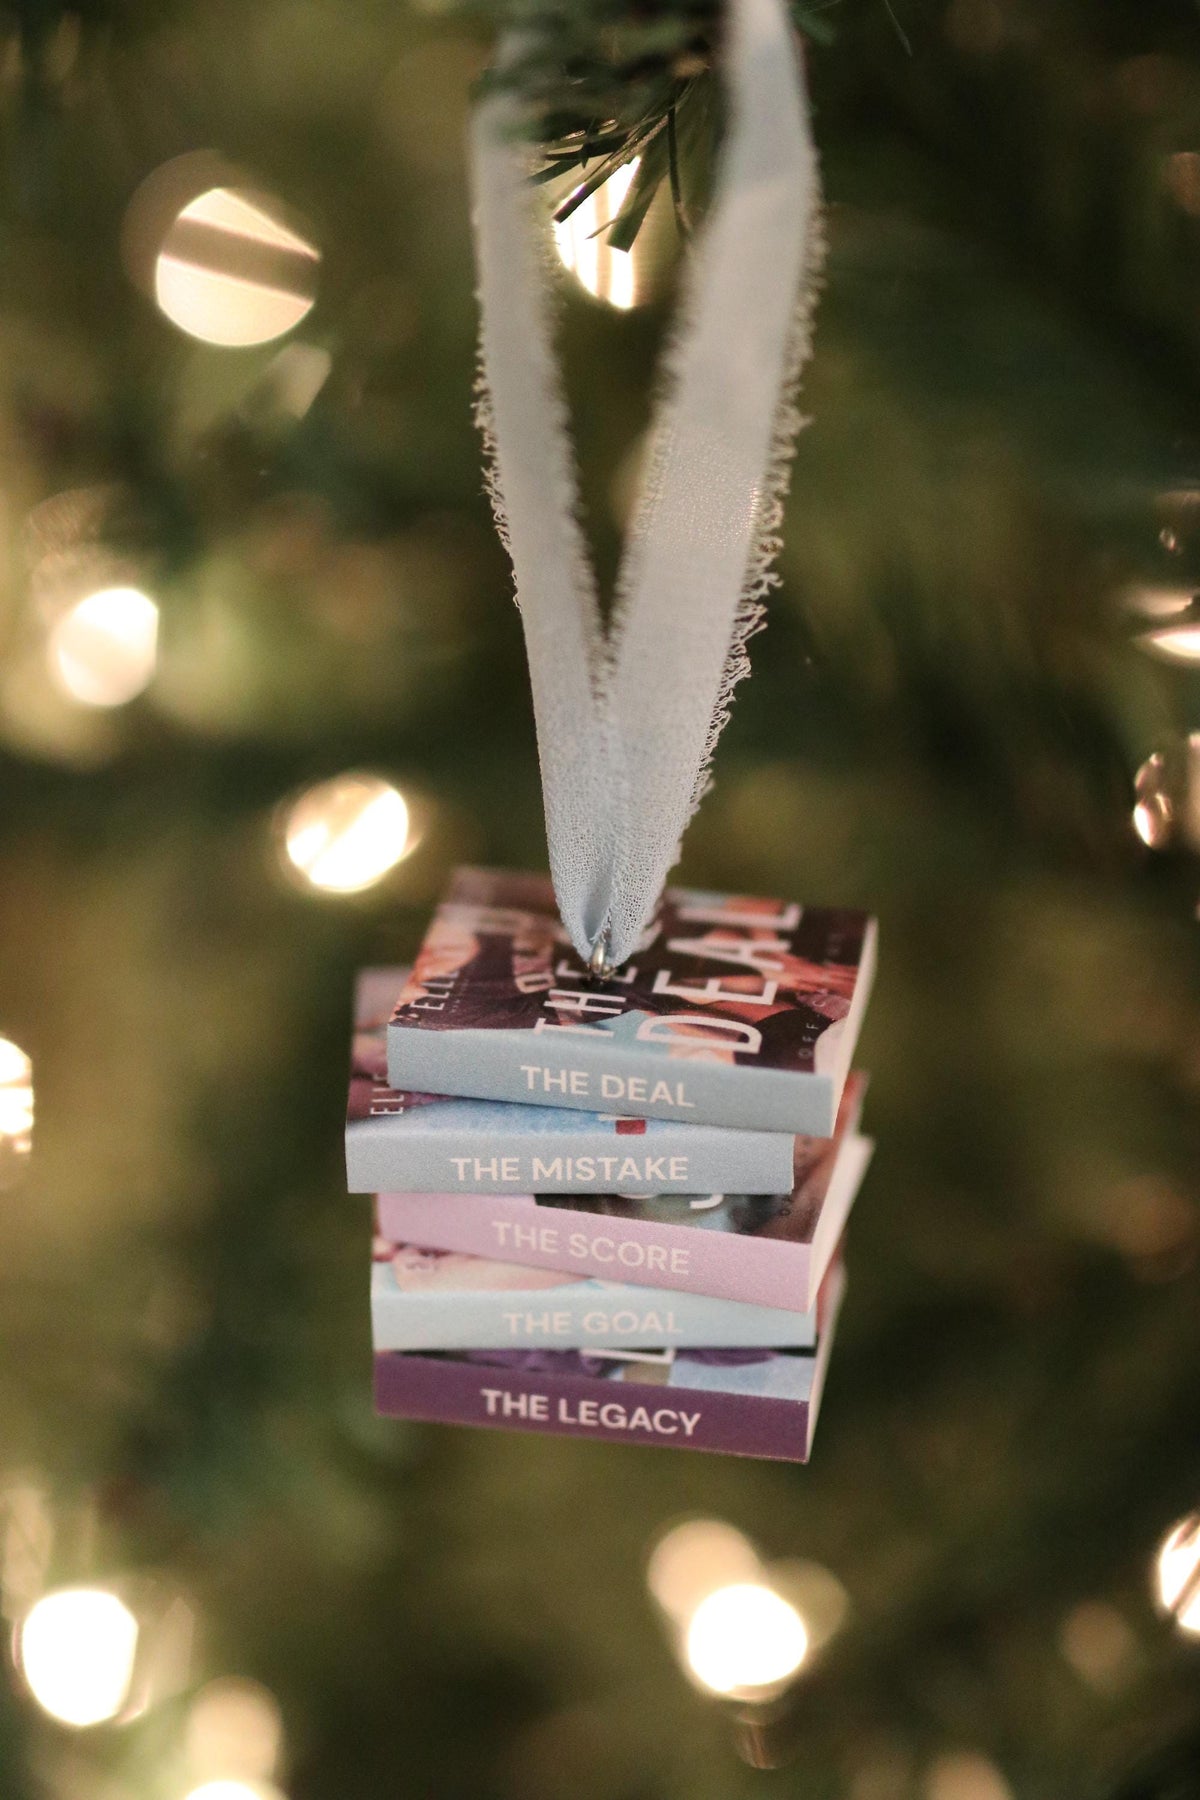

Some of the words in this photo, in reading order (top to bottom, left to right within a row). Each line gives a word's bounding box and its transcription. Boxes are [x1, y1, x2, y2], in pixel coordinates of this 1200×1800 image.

[636, 902, 802, 1055] DEAL
[519, 1064, 589, 1096] THE
[601, 1074, 696, 1109] DEAL
[450, 1157, 521, 1182] THE
[531, 1156, 690, 1182] MISTAKE
[491, 1220, 560, 1254] THE
[568, 1232, 690, 1276] SCORE
[502, 1311, 572, 1335] THE
[581, 1310, 685, 1335] GOAL
[480, 1388, 550, 1422] THE
[557, 1397, 702, 1437] LEGACY
